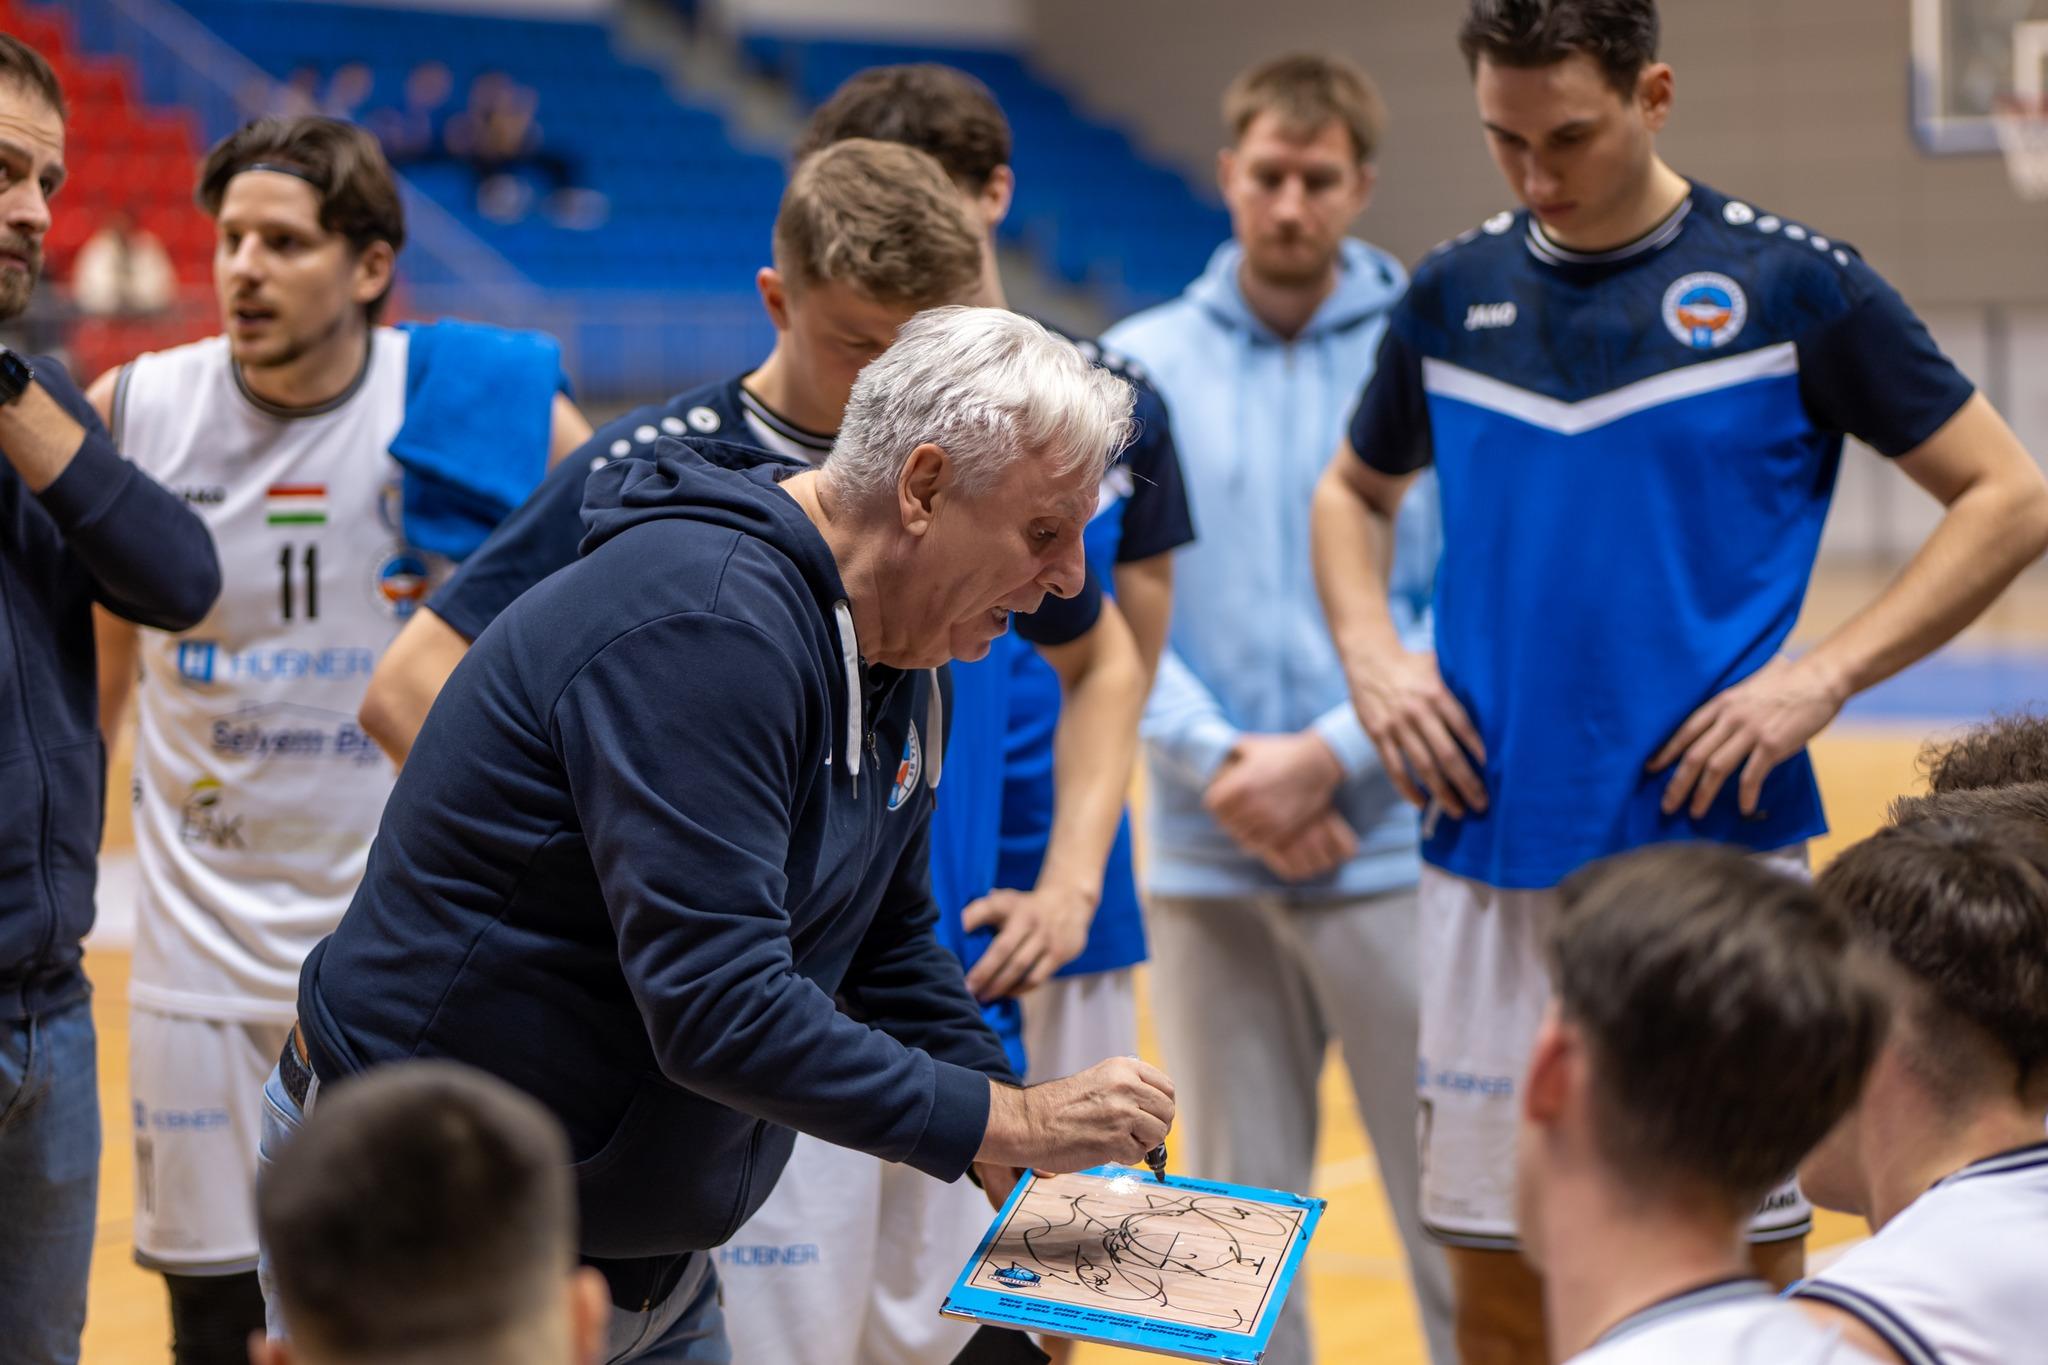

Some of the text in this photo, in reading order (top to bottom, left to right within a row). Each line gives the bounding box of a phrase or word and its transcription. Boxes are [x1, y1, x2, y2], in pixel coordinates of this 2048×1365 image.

[1463, 302, 1517, 331] JAKO
[278, 544, 318, 620] 11
[1053, 1307, 1083, 1315] play
[1087, 1312, 1140, 1325] without
[1137, 1325, 1191, 1338] without
